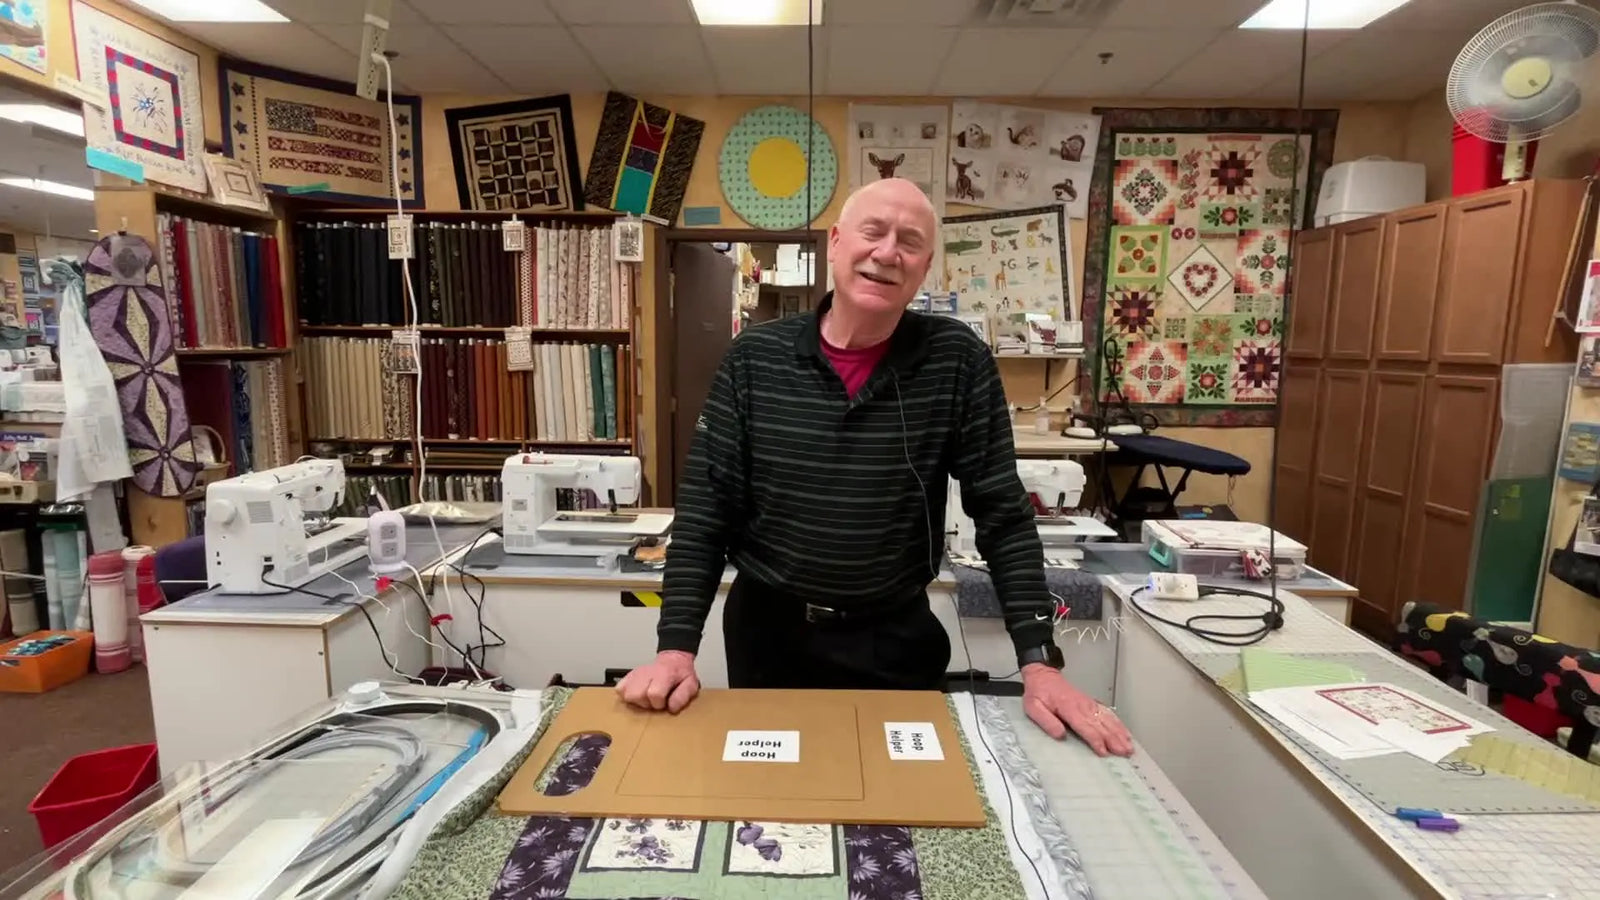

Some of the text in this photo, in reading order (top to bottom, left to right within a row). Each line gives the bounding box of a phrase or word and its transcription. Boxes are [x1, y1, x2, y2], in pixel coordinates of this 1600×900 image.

[737, 739, 782, 748] Helper
[889, 730, 904, 753] Helper
[911, 732, 924, 751] Hoop
[740, 750, 776, 759] Hoop
